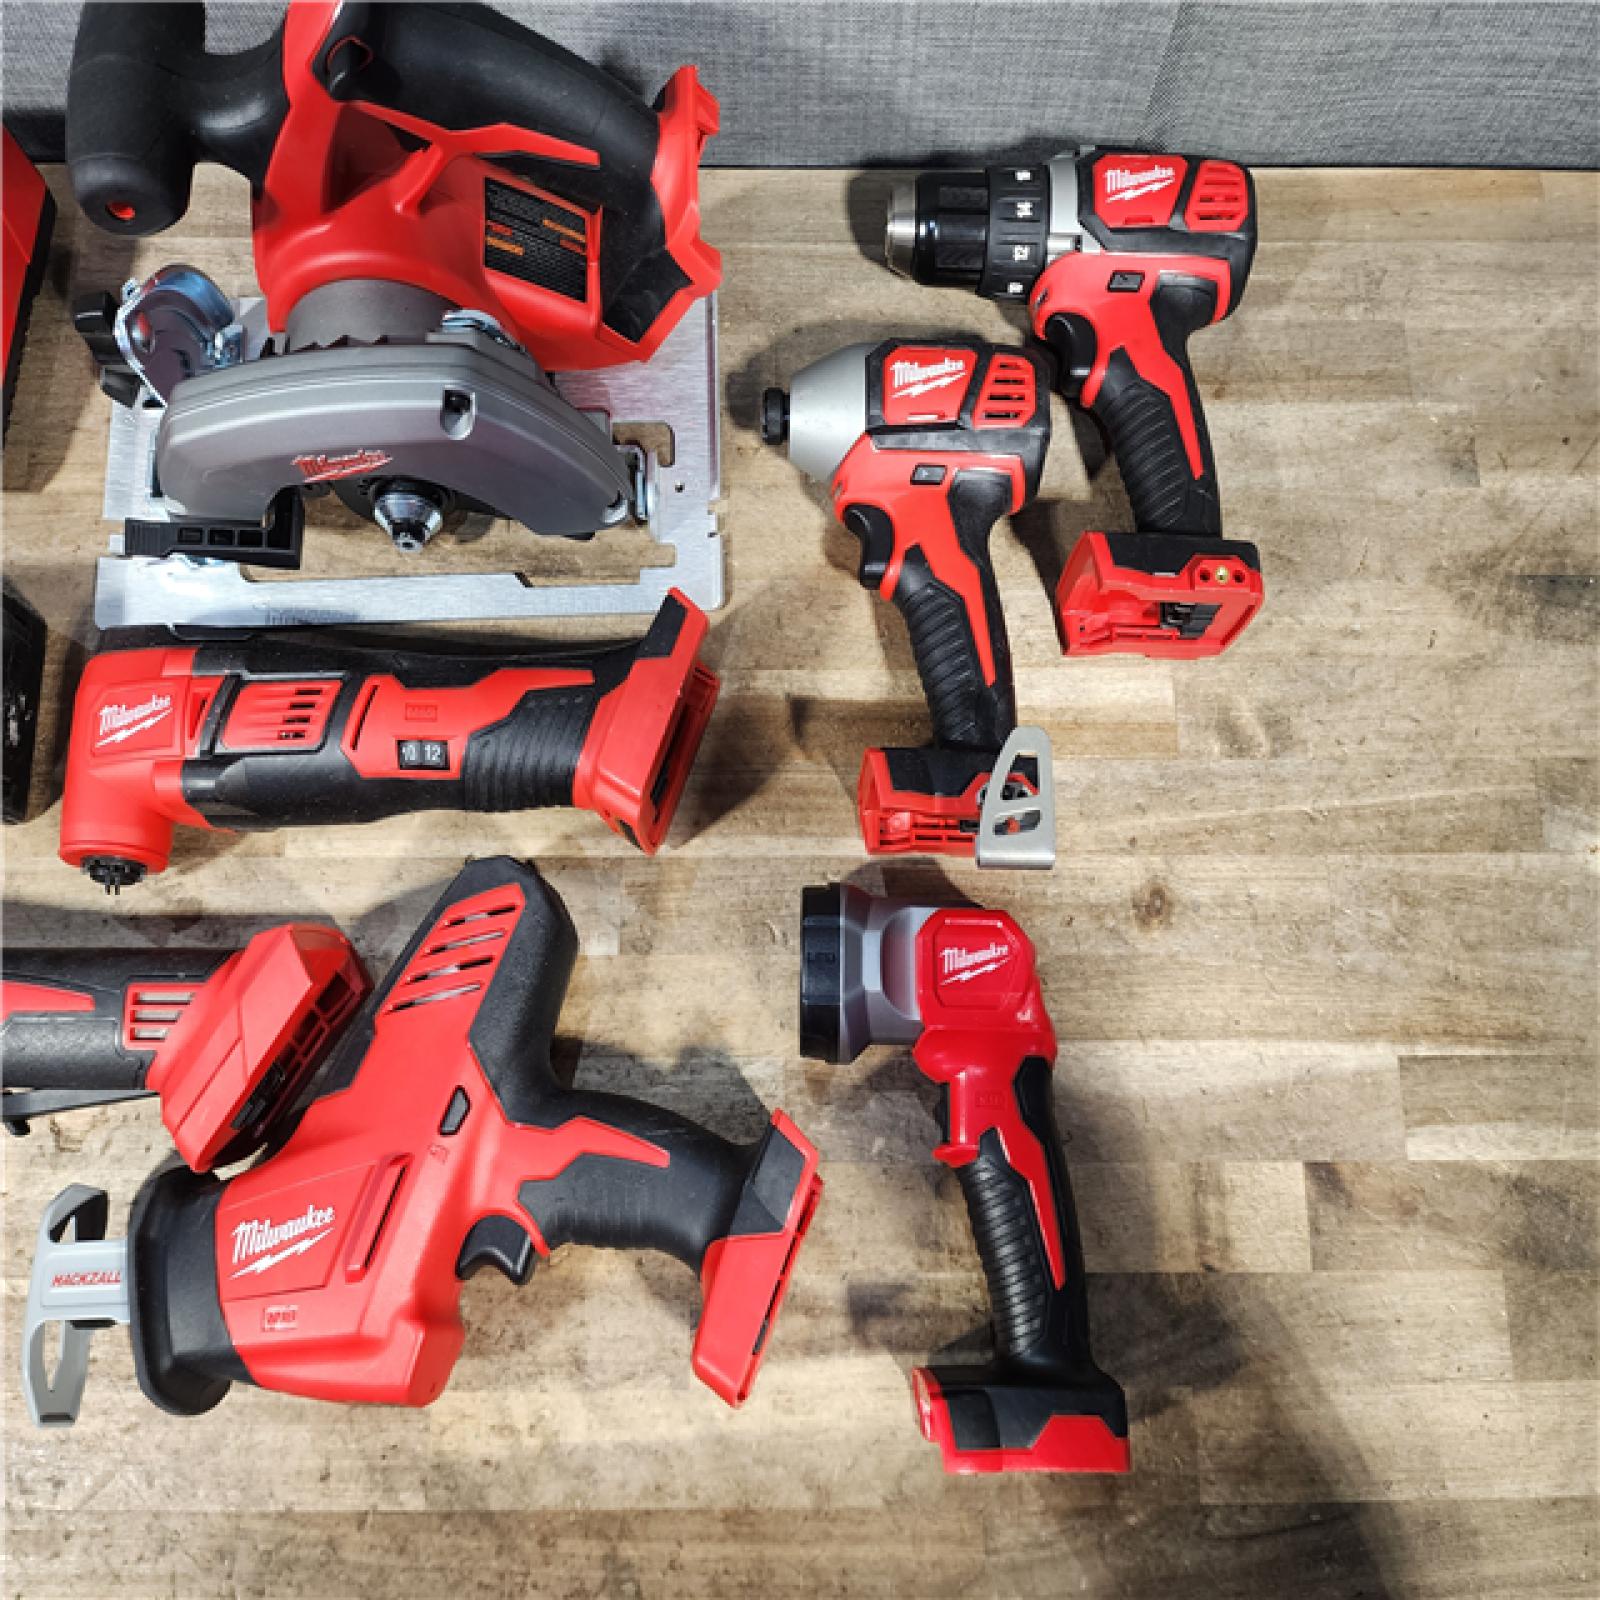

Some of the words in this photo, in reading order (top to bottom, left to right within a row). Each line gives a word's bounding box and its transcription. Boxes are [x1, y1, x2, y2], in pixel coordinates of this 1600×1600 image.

[1104, 165, 1175, 193] Milwaukee
[890, 357, 965, 388] Milwaukee
[99, 693, 171, 735] Milwaukee
[424, 745, 441, 761] 12
[939, 942, 1008, 974] Milwaukee
[231, 1204, 335, 1265] Milwaukee
